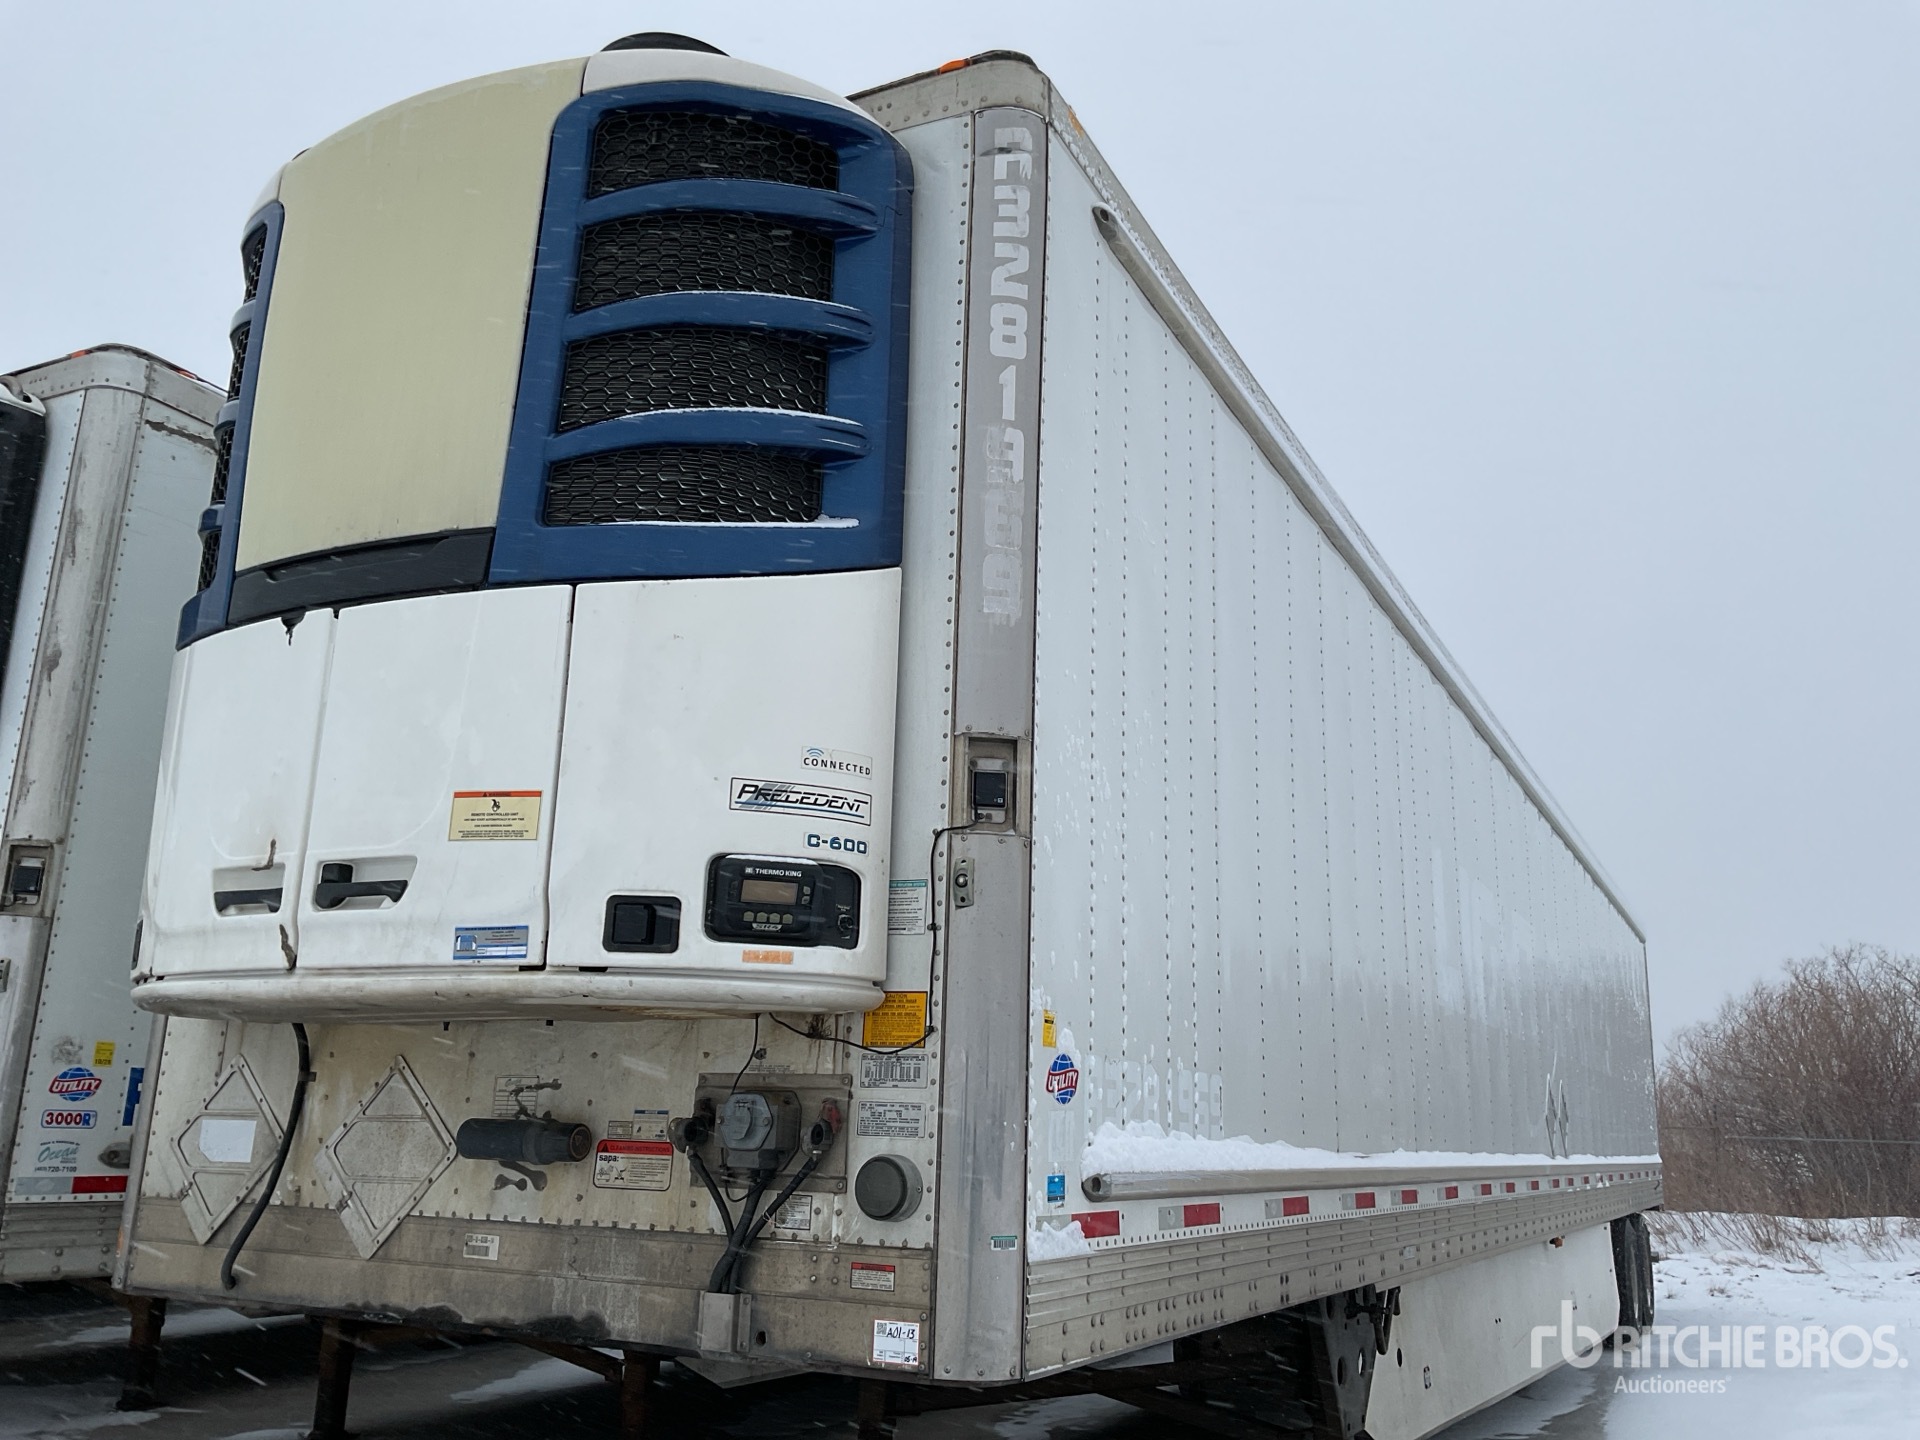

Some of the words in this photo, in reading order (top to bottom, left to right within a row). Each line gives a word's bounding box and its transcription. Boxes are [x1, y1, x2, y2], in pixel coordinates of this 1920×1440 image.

[803, 757, 871, 776] CONNECTED
[736, 783, 869, 814] PRECEDENT
[807, 833, 868, 854] C-600
[755, 867, 784, 876] THERMO
[785, 869, 802, 877] KING
[52, 1078, 98, 1093] UTILITY
[1048, 1071, 1078, 1091] UTILITY
[886, 1326, 916, 1340] A01-13
